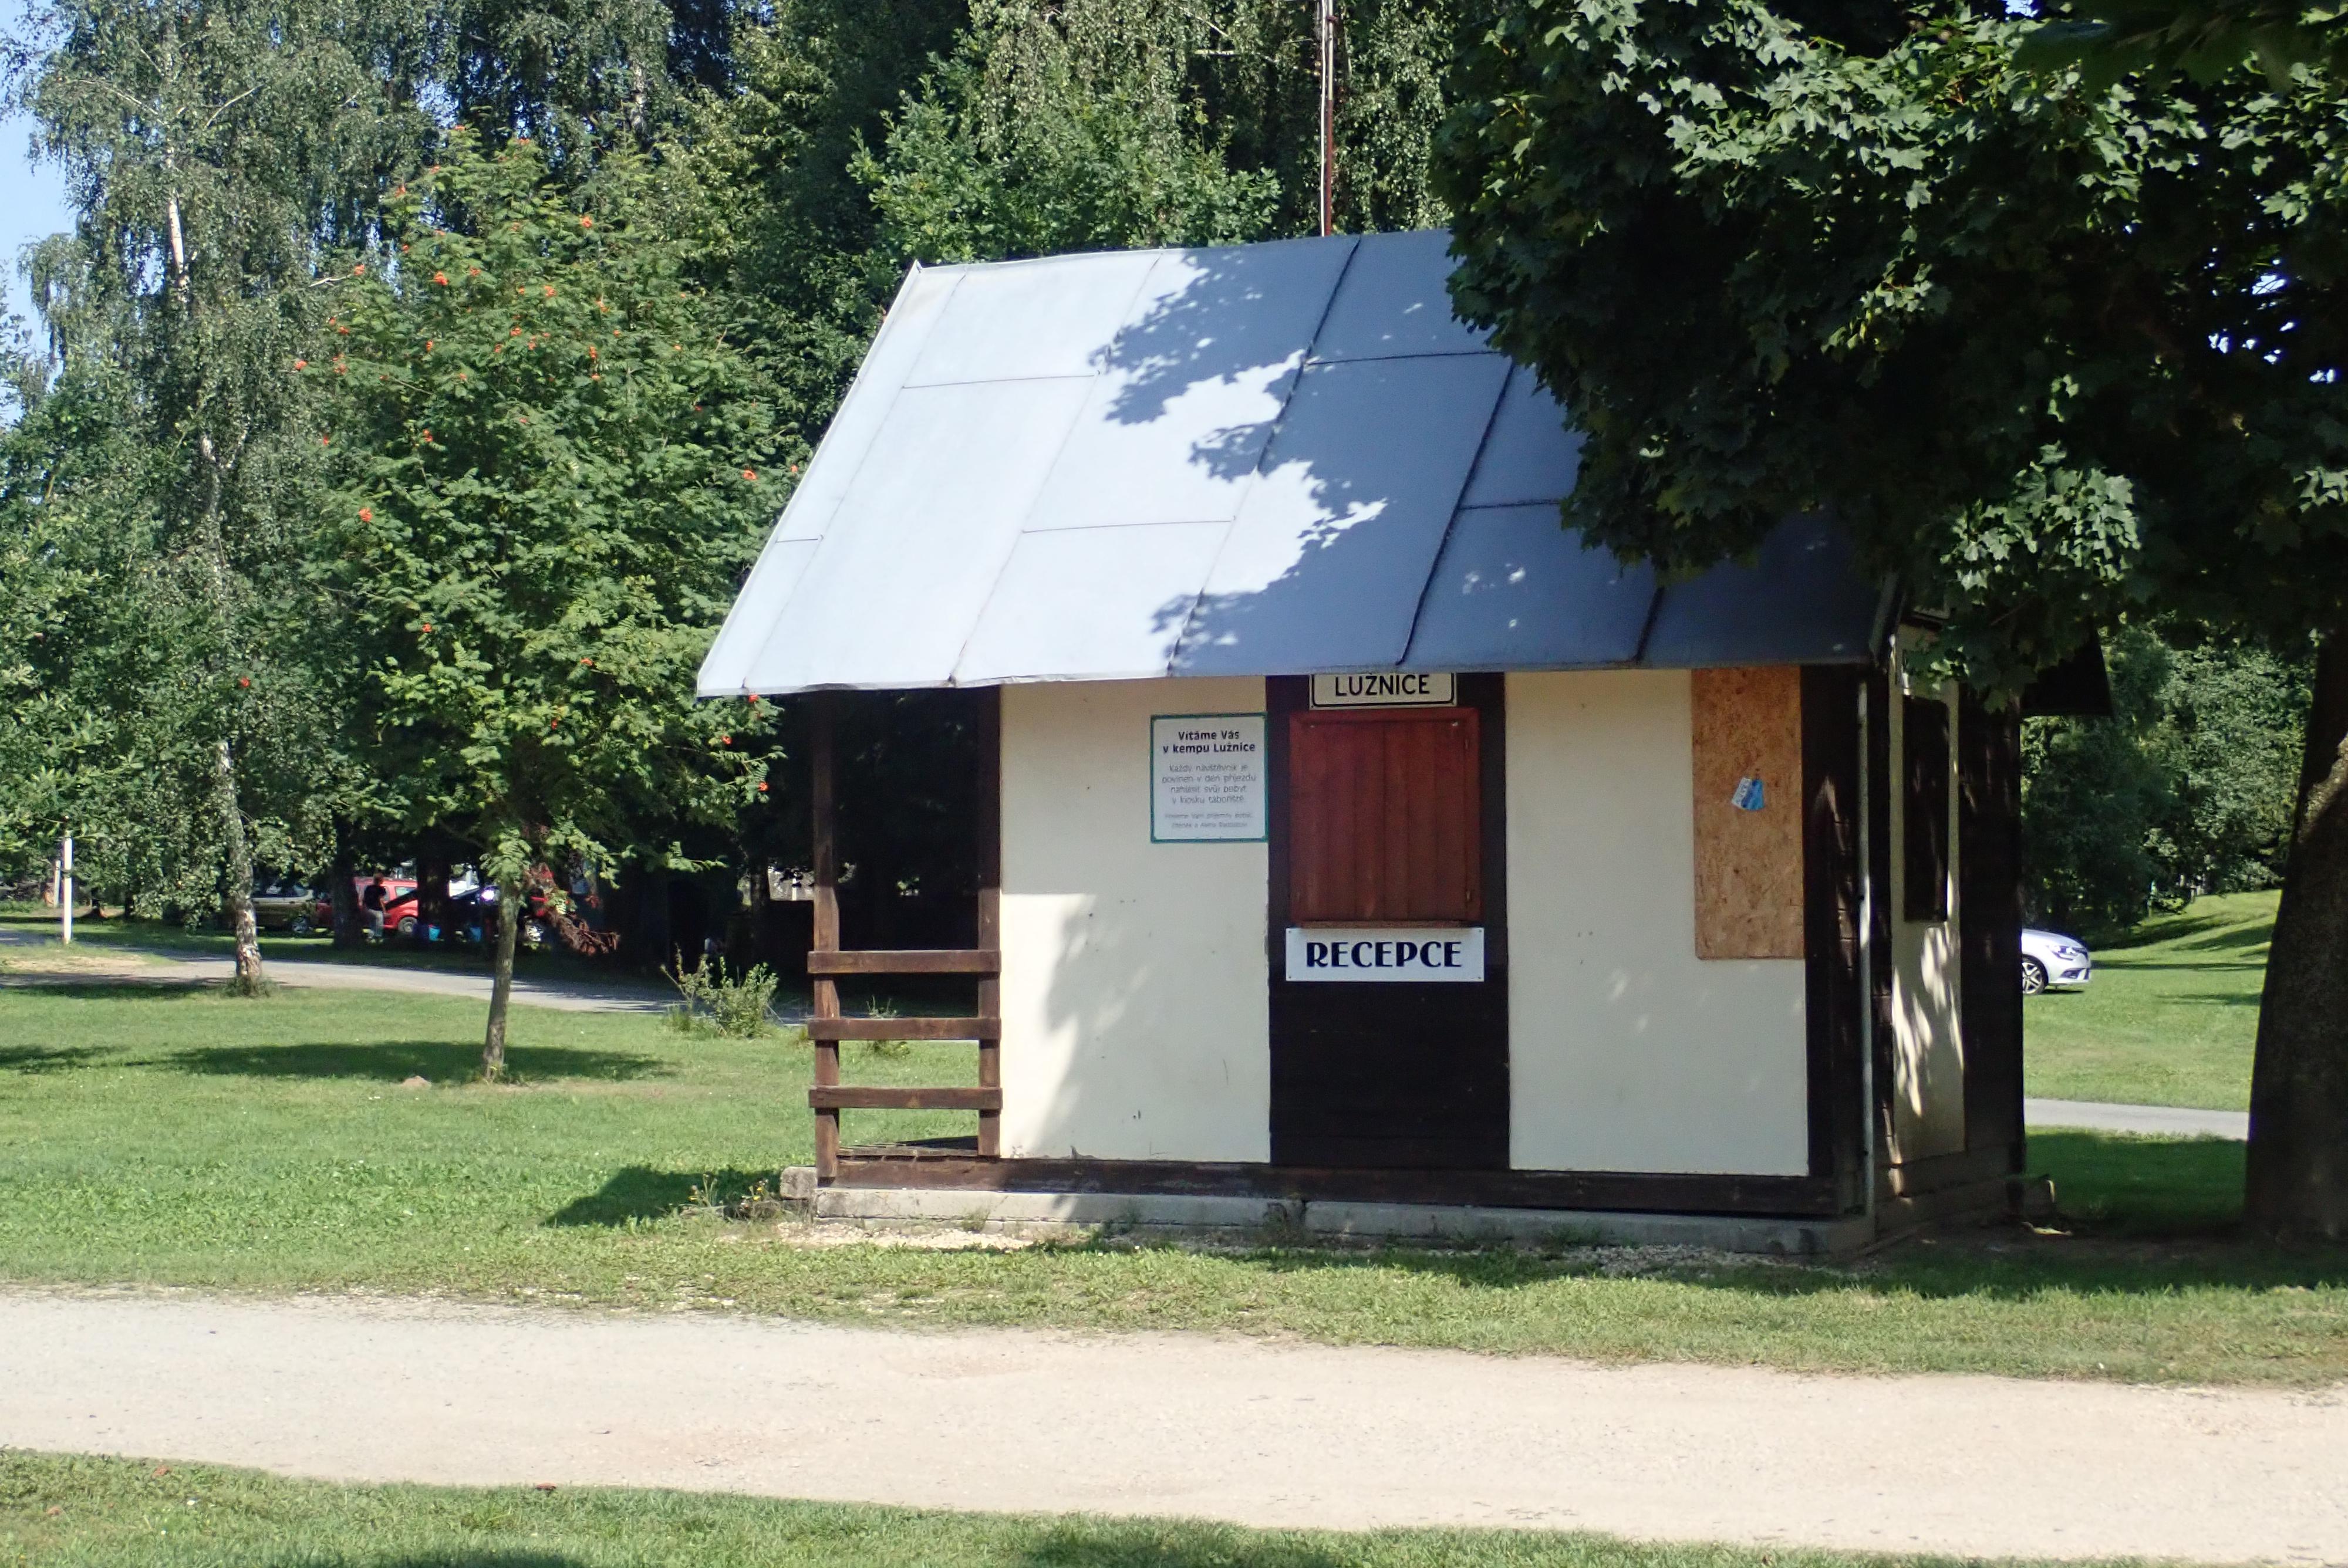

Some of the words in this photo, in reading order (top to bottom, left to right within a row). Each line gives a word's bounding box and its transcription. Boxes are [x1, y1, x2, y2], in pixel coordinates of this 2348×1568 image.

[1221, 729, 1240, 739] Vás
[1163, 745, 1169, 753] v
[1173, 744, 1209, 754] kempu
[1306, 941, 1462, 968] RECEPCE
